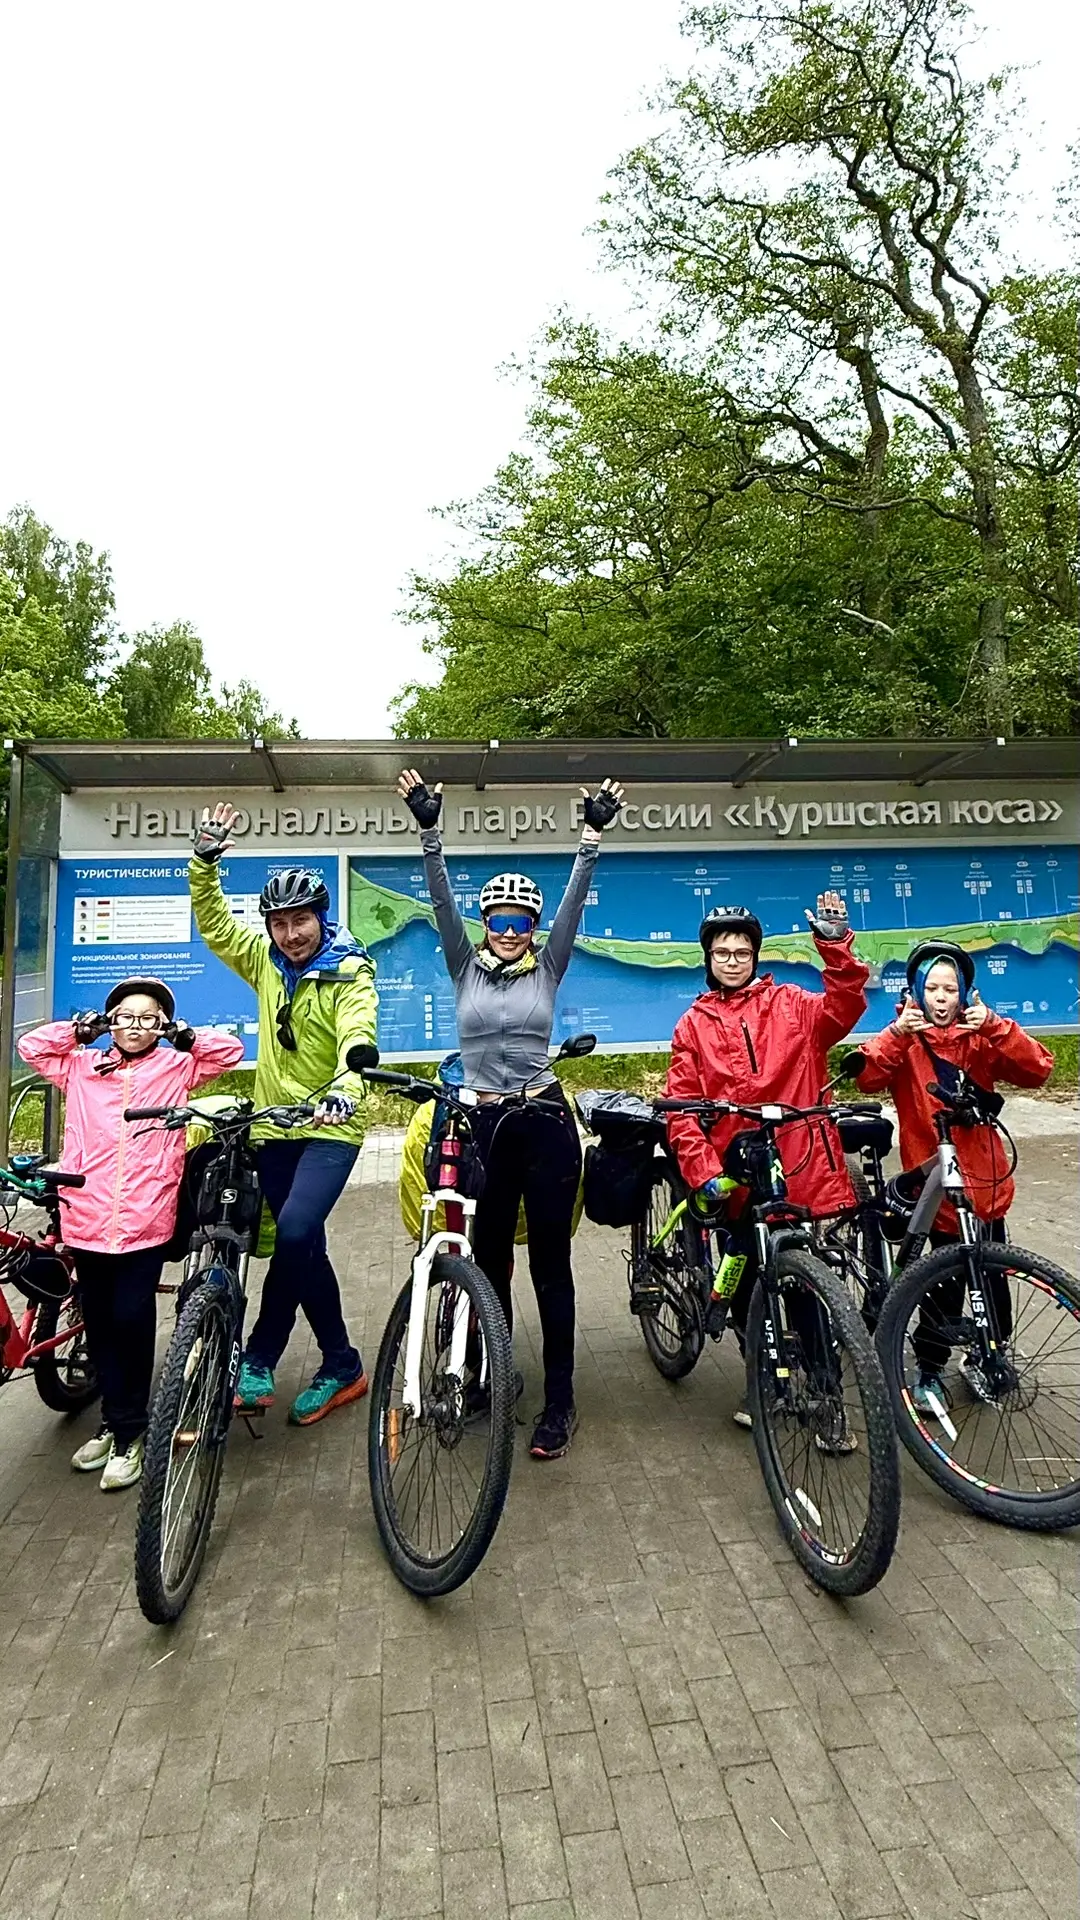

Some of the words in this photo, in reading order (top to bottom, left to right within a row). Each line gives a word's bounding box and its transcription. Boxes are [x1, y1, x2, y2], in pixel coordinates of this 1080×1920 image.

[108, 801, 444, 840] Нацональны
[458, 803, 557, 840] парк
[723, 795, 942, 836] «Куршская
[951, 799, 1064, 824] коса»
[74, 868, 172, 879] ТУРИСТИЧЕСКИЕ
[71, 953, 139, 962] ФУНКЦИОНАЛЬНОЕ
[140, 951, 191, 960] ЗОНИРОВАНИЕ
[376, 983, 414, 992] ОЗНАЧЕНИЯ
[723, 1256, 746, 1297] RUSH
[969, 1290, 985, 1313] NS
[974, 1316, 989, 1328] 24
